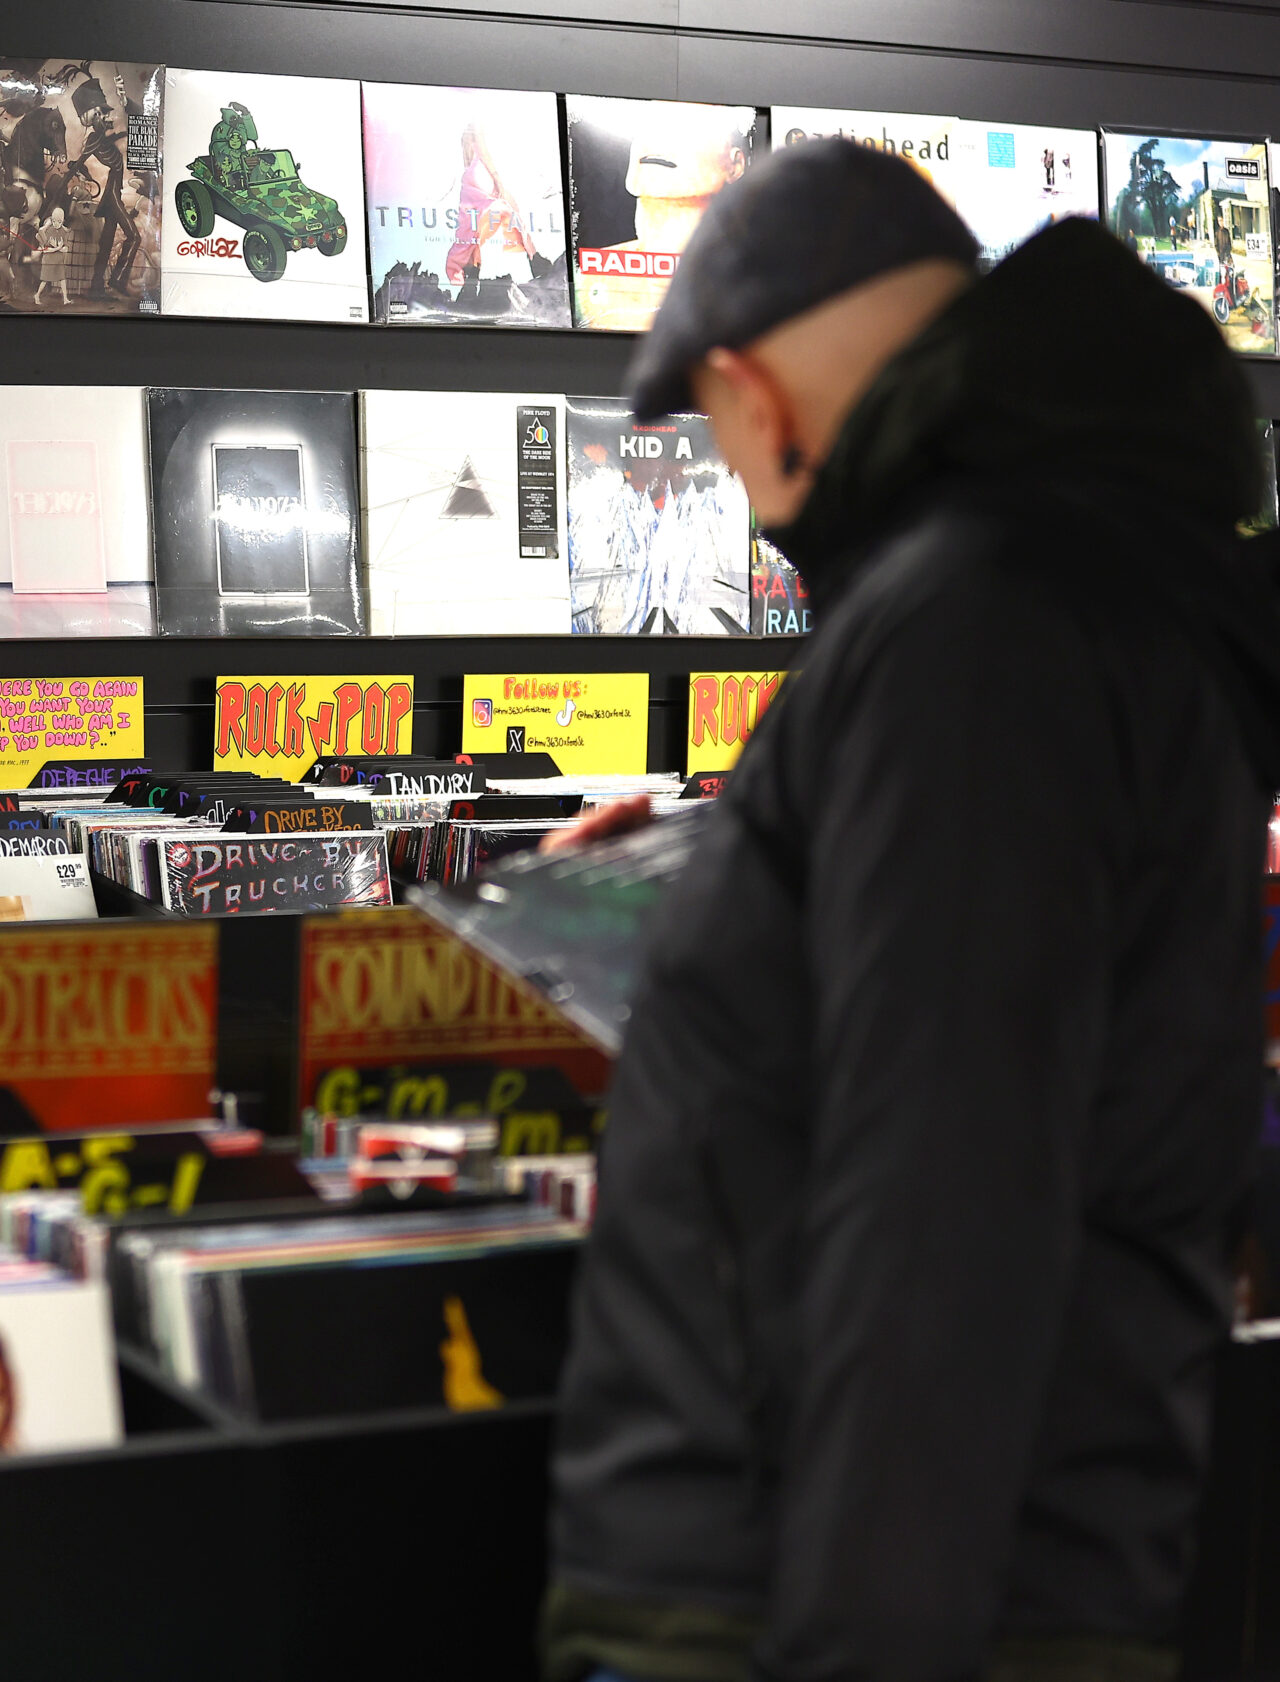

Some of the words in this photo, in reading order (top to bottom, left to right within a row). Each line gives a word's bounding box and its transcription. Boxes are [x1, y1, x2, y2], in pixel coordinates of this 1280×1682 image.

[129, 134, 158, 147] PARADE
[1229, 163, 1258, 175] oasis
[619, 435, 663, 458] KID
[675, 436, 694, 459] A
[35, 680, 63, 698] YOU
[69, 681, 90, 697] GO
[93, 680, 138, 697] AGAIN
[29, 697, 72, 713] WANT
[76, 697, 114, 716] YOUR
[8, 715, 46, 734] WELL
[52, 714, 83, 730] WHO
[88, 713, 113, 730] AM
[117, 712, 130, 729] I
[215, 681, 306, 758] ROCK
[333, 681, 412, 756] POP
[13, 734, 39, 752] YOU
[40, 766, 115, 788] DEPECHE
[427, 774, 474, 796] DURY
[264, 808, 317, 833] DRIVE
[321, 805, 347, 829] BY
